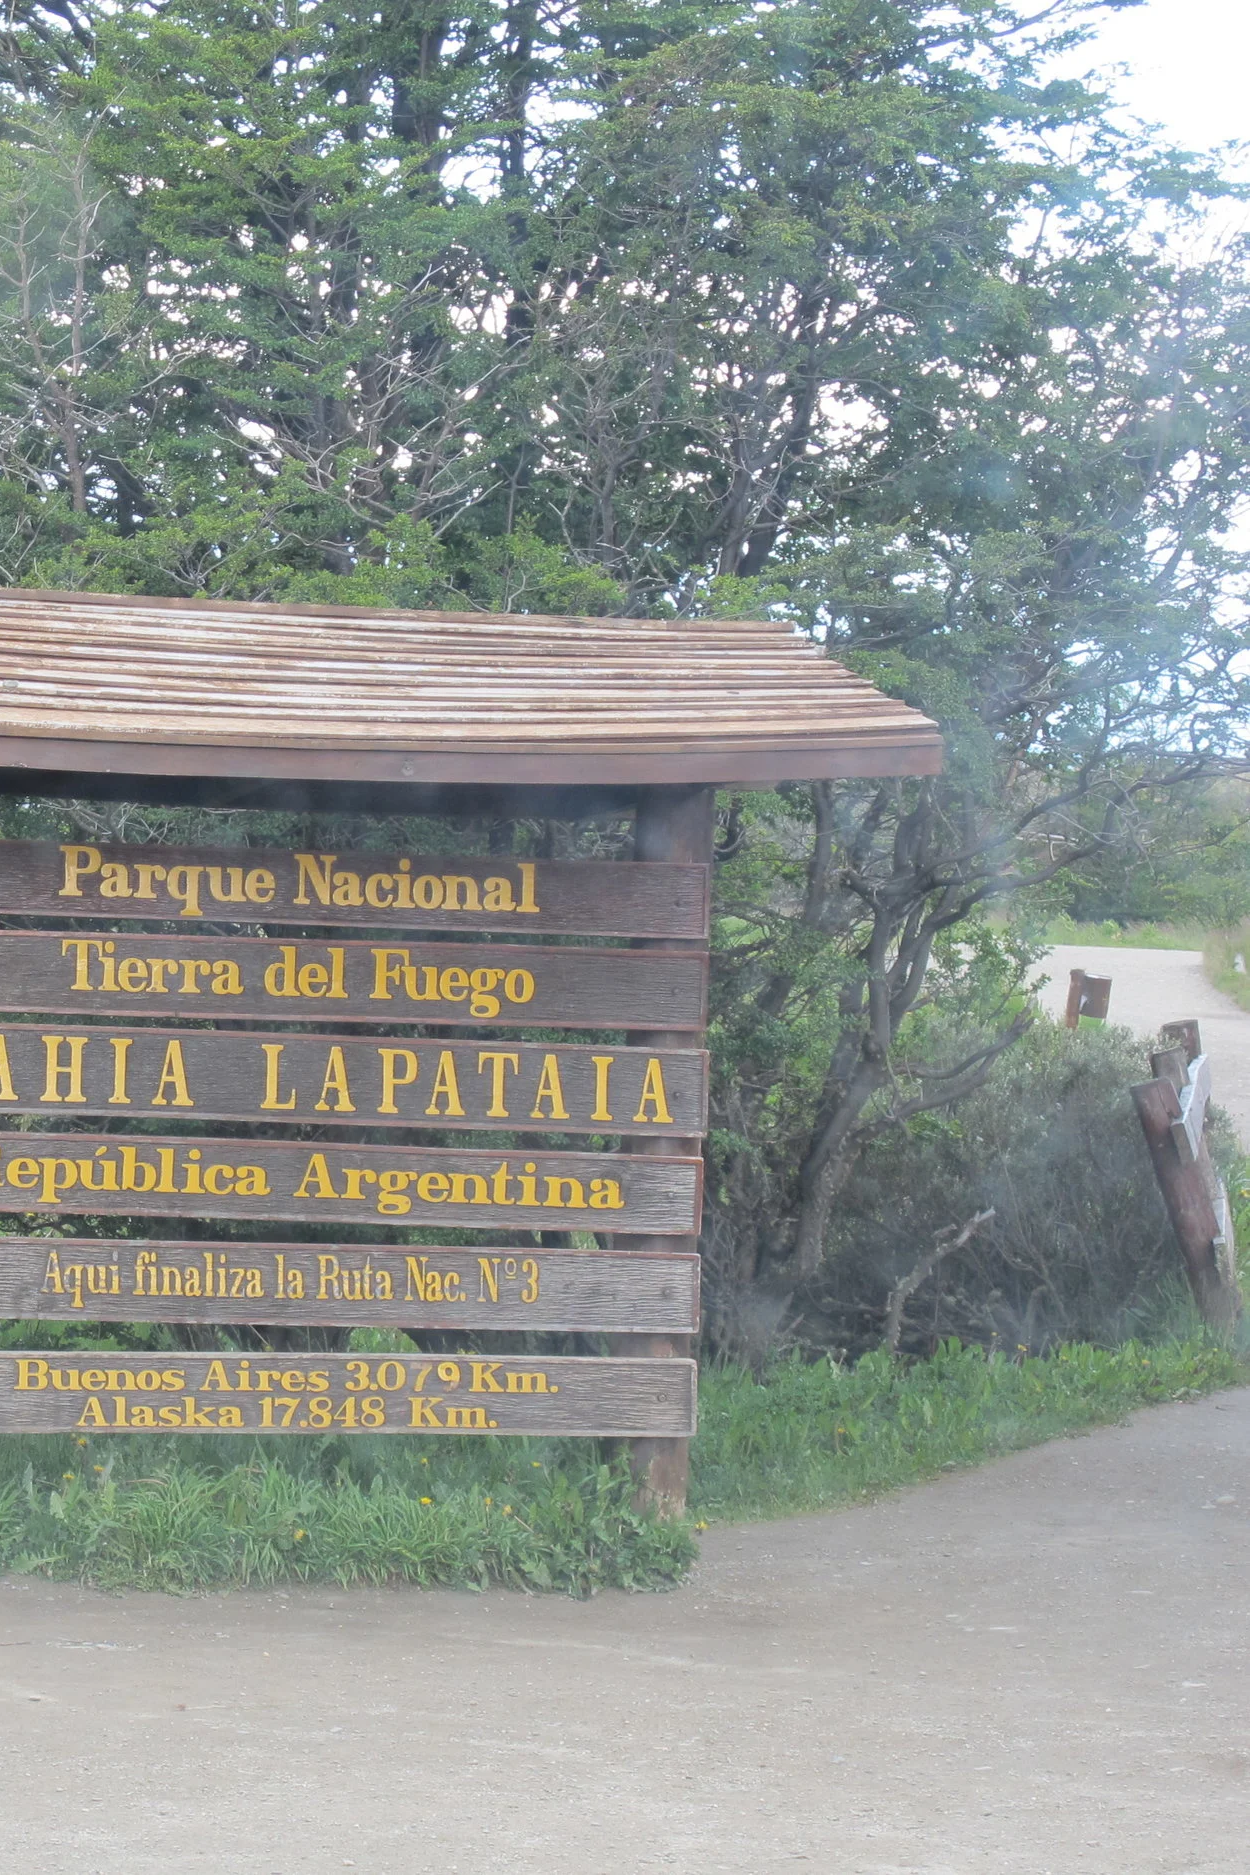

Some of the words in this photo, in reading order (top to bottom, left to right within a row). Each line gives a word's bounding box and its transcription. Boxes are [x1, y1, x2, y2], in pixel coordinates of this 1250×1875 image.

[59, 846, 276, 916] Parque
[294, 854, 540, 913] Nacional
[62, 939, 244, 995] Tierra
[264, 946, 349, 998] del
[370, 948, 536, 1018] Fuego
[261, 1044, 674, 1123] LAPATAIA
[293, 1153, 625, 1215] Argentina
[40, 1250, 121, 1308] Aqui
[133, 1251, 265, 1298] finaliza
[276, 1255, 305, 1299] la
[317, 1255, 394, 1300] Ruta
[405, 1256, 466, 1302] Nac.
[14, 1359, 186, 1392] Buenos
[200, 1360, 330, 1393] Aires
[345, 1361, 462, 1392] 3.079
[470, 1362, 559, 1393] Km.
[77, 1396, 245, 1428] Alaska
[259, 1396, 386, 1429] 17.848
[409, 1397, 498, 1429] Km.
